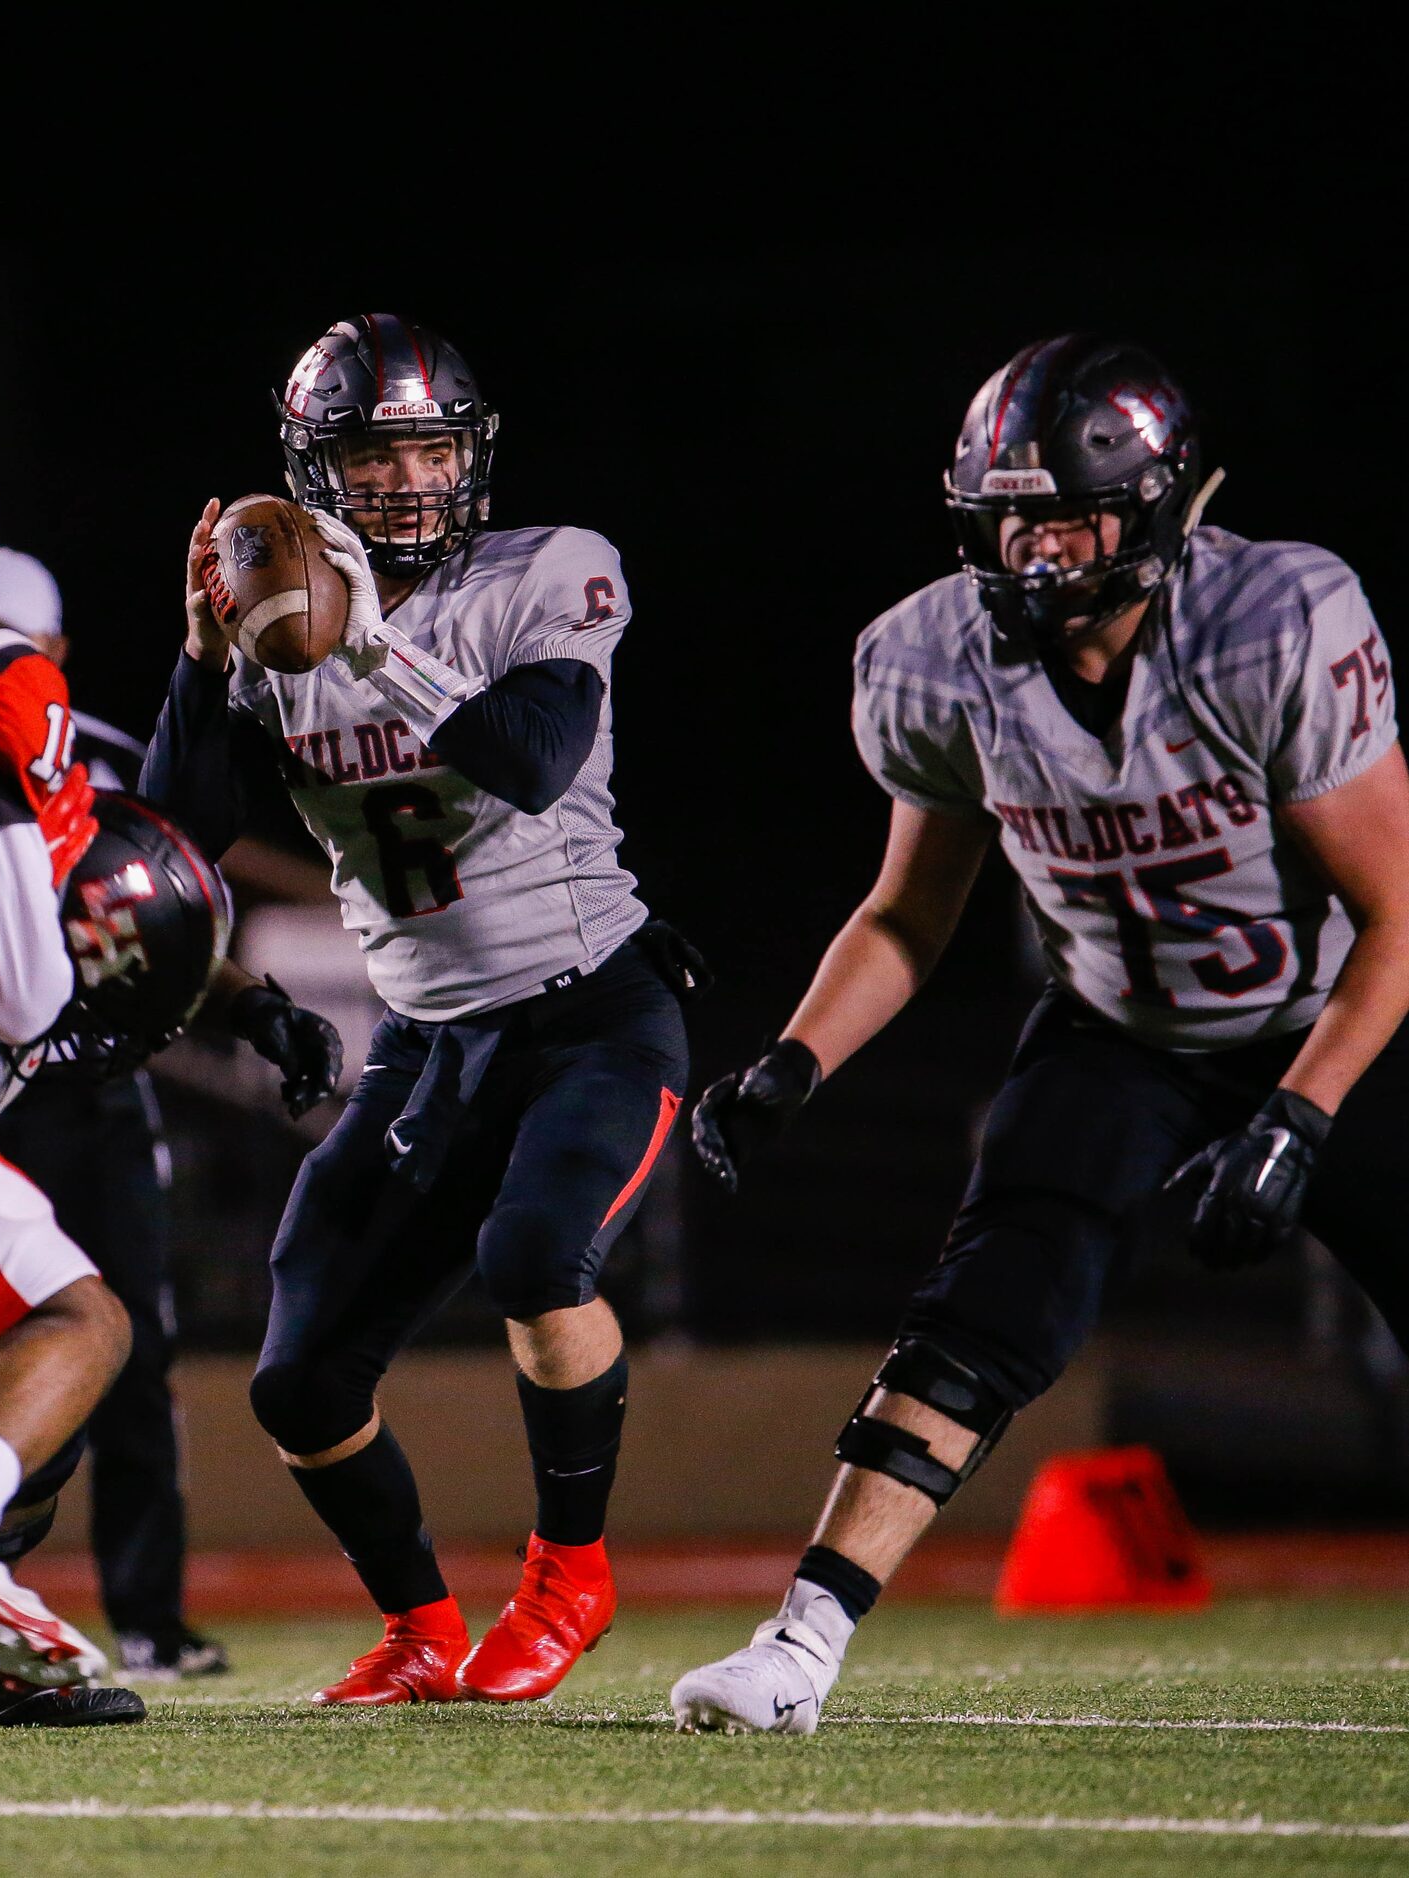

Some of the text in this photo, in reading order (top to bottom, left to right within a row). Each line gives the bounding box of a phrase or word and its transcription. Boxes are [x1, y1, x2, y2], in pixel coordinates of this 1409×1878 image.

[381, 402, 435, 418] Riddell
[993, 773, 1259, 863] WILDCATS
[1047, 847, 1290, 1008] 75
[556, 975, 572, 989] M
